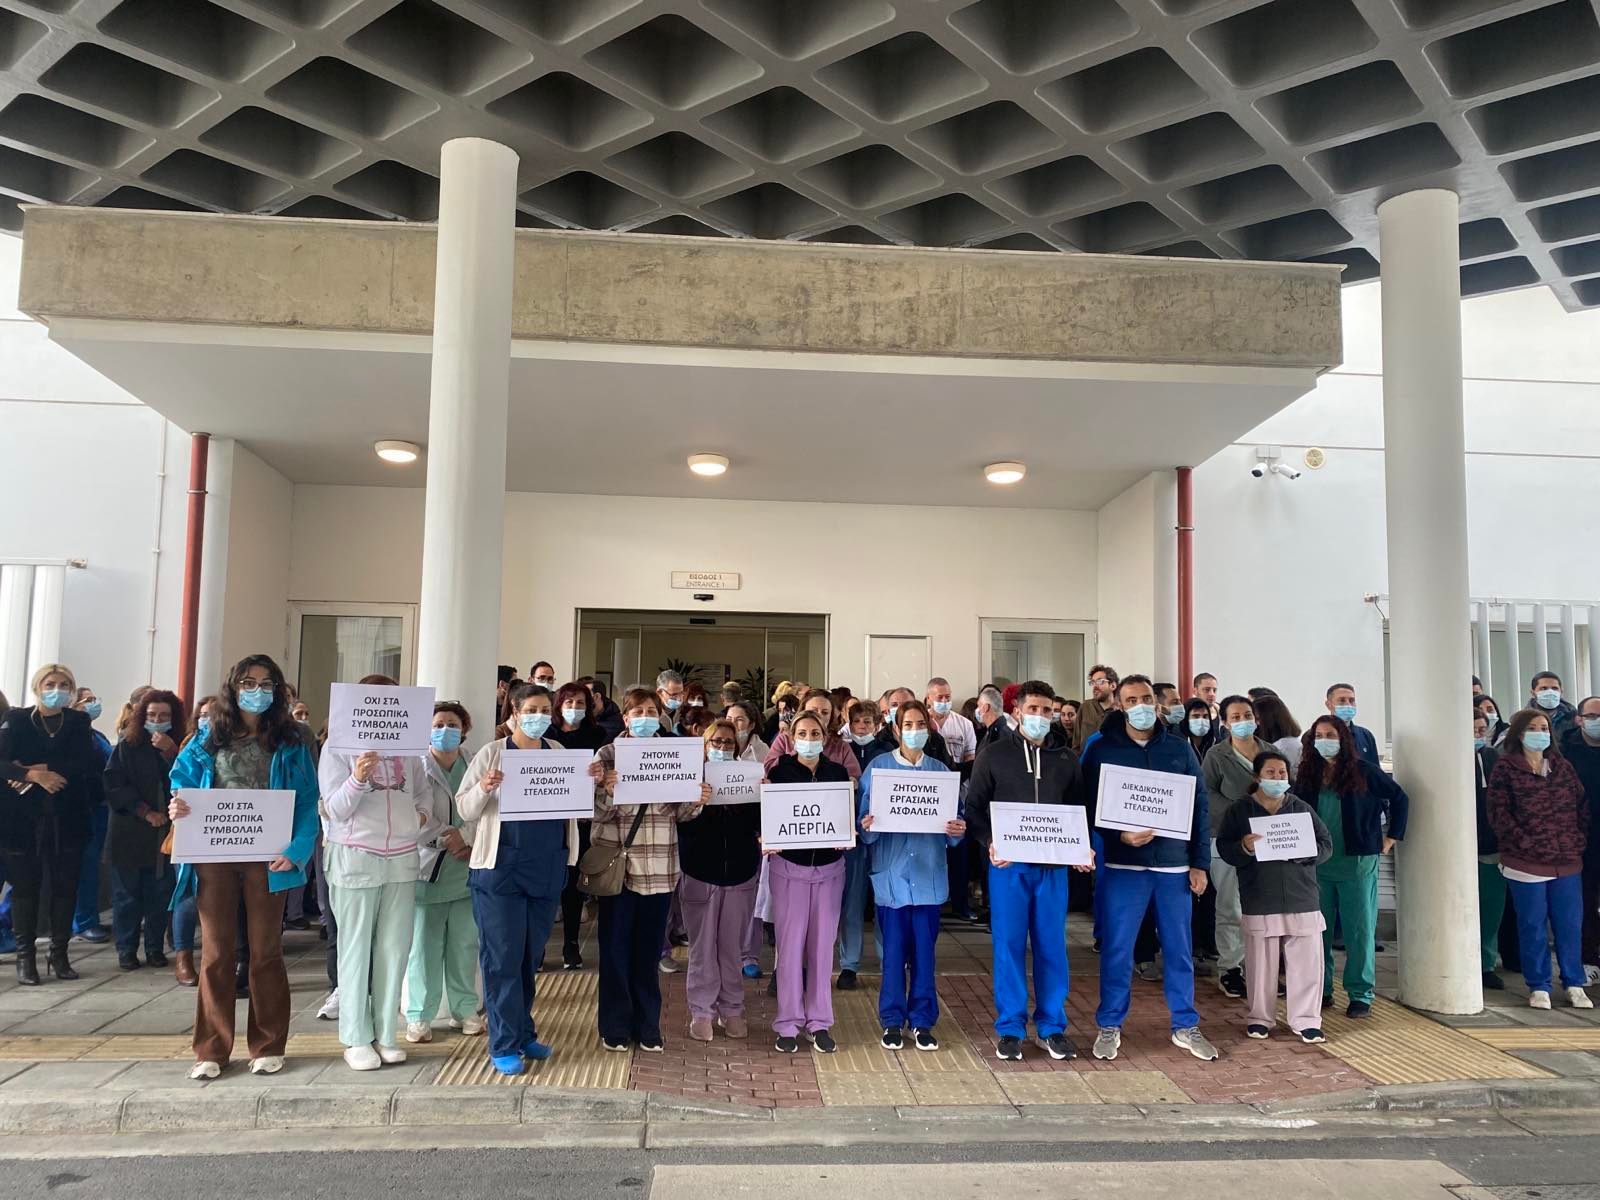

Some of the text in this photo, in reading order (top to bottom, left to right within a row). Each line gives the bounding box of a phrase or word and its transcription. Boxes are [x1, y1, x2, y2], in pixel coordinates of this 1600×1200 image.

[364, 696, 400, 706] ΟΧΙ ΣΤΑ
[353, 708, 408, 718] ΠΡΟΣΩΠΙΚΑ
[352, 720, 408, 729] ΣΥΜΒΟΛΑΙΑ
[358, 732, 400, 740] ΕΡΓΑΣΙΑΣ
[520, 766, 576, 774] ΔΙΕΚΔΙΚΟΥΜΕ
[639, 762, 682, 770] ΣΥΛΛΟΓΙΚΗ
[529, 777, 565, 785] ΑΣΦΑΛΗ
[622, 773, 697, 782] ΣΥΜΒΑΣΗ ΕΡΓΑΣΙΑΣ
[726, 774, 744, 783] ΕΔΩ
[524, 788, 570, 796] ΣΤΕΛΕΧΩΣΗ
[717, 786, 754, 796] ΑΠΕΡΓΙΑ
[893, 784, 938, 794] ΖΗΤΟΥΜΕ
[1122, 782, 1174, 796] ΔΙΕΚΔΙΚΟΥΜΕ
[890, 795, 940, 804] ΕΡΓΑΣΙΑΚΗ
[1130, 794, 1164, 804] ΑΣΦΑΛΗ
[217, 802, 254, 810] ΟΧΙ ΣΤΑ
[793, 804, 821, 817] ΕΔΩ
[1124, 802, 1168, 815] ΣΤΕΛΕΧΩΣΗ
[890, 806, 938, 816] ΑΣΦΑΛΕΙΑ
[205, 814, 264, 822] ΠΡΟΣΩΠΙΚΑ
[1020, 816, 1059, 824] ΖΗΤΟΥΜΕ
[203, 826, 263, 834] ΣΥΜΒΟΛΑΙΑ
[778, 822, 836, 836] ΑΠΕΡΓΙΑ
[1020, 826, 1063, 834] ΣΥΛΛΟΓΙΚΗ
[210, 837, 255, 846] ΕΡΓΑΣΙΑΣ
[1004, 834, 1080, 844] ΣΥΜΒΑΣΗ ΕΡΓΑΣΙΑΣ
